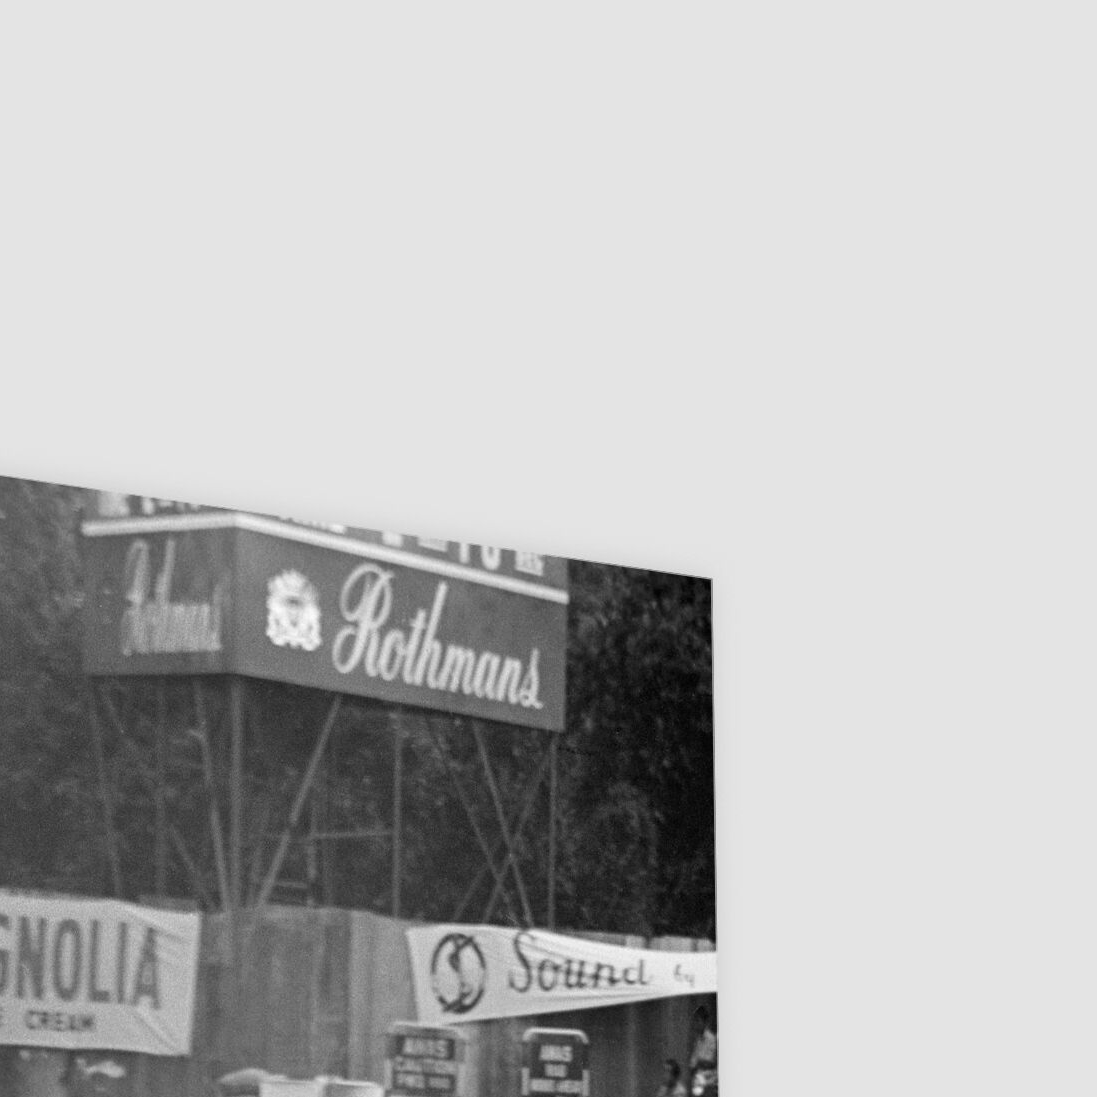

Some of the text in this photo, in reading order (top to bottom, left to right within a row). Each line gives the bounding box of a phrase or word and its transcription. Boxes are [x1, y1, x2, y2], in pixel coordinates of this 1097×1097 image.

[332, 563, 544, 710] Rothmans
[507, 930, 648, 993] Sound
[25, 1009, 96, 1032] CREAM
